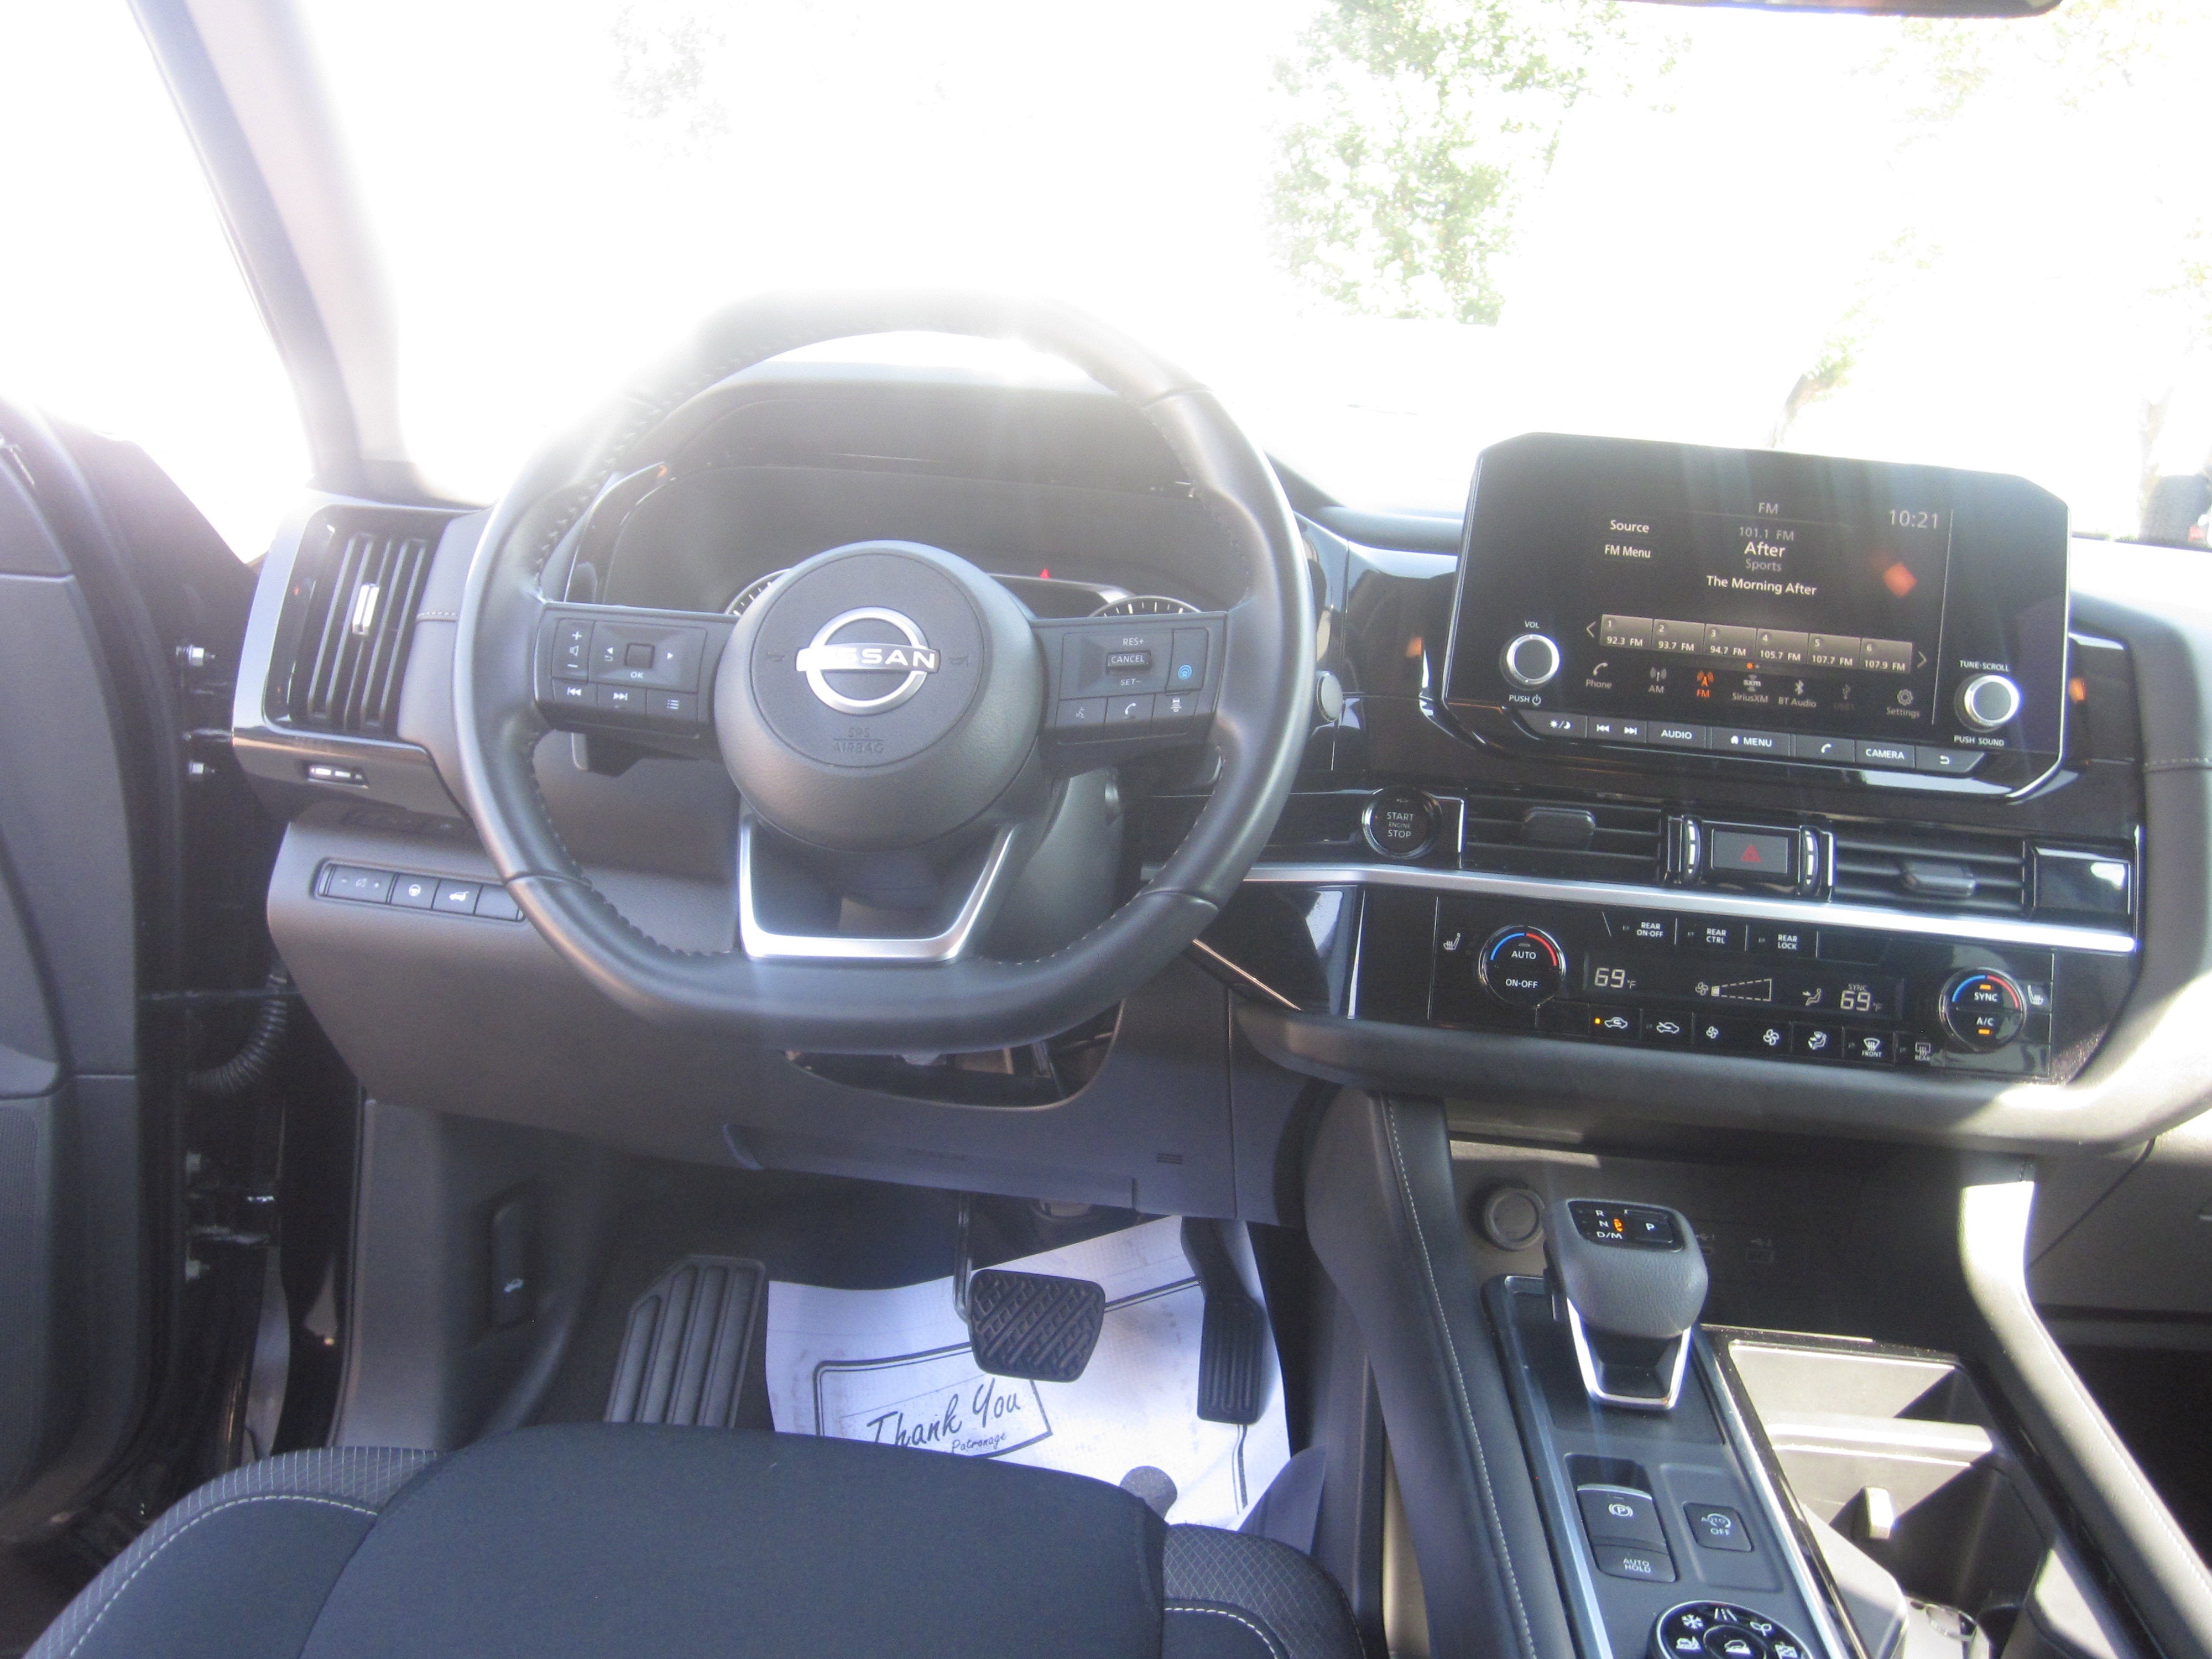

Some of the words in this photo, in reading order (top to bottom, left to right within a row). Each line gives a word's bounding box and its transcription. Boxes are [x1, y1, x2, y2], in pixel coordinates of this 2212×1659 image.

[1759, 502, 1779, 515] FM
[1890, 509, 1938, 529] 10:21
[1610, 519, 1650, 534] Source
[1739, 526, 1770, 540] 101.1
[1776, 529, 1795, 541] FM
[1604, 544, 1620, 556] FM
[1623, 546, 1651, 559] Menu
[1744, 541, 1786, 559] After
[1745, 559, 1782, 573] Sports
[1706, 575, 1728, 588] The
[1731, 577, 1782, 596] Morning
[1785, 582, 1818, 596] After
[1524, 620, 1540, 629] VOL
[1607, 620, 1612, 628] 1
[1658, 624, 1665, 633] 2
[1710, 629, 1717, 638] 3
[1762, 634, 1768, 643] 4
[1606, 636, 1626, 646] 92.3
[1629, 638, 1644, 647] FM
[1658, 640, 1677, 650] 93.7
[1681, 642, 1695, 652] FM
[1814, 639, 1820, 647] 5
[1710, 645, 1729, 655] 94.7
[1733, 647, 1746, 657] FM
[1866, 643, 1872, 652] 6
[1760, 650, 1783, 660] 105.7
[1787, 652, 1801, 662] FM
[1811, 655, 1836, 665] 107.7
[1839, 657, 1853, 667] FM
[1864, 659, 1888, 670] 107.9
[1892, 662, 1906, 672] FM
[1585, 679, 1612, 690] Phone
[1648, 685, 1664, 694] AM
[1509, 694, 1531, 704] PUSH
[1696, 689, 1711, 698] FM
[1731, 692, 1768, 704] SiriusXM
[1778, 696, 1791, 706] BT
[1792, 697, 1817, 708] Audio
[1886, 706, 1921, 719] Settings
[1661, 729, 1692, 740] AUDIO
[1743, 736, 1772, 748] MENU
[1953, 734, 1975, 745] PUSH
[1978, 737, 2005, 748] SOUND
[834, 742, 884, 753] AIRBAG
[1865, 748, 1905, 760] CAMERA
[1386, 812, 1415, 821] START
[1387, 830, 1412, 838] STOP
[1640, 921, 1661, 930] REAR
[1706, 928, 1727, 937] REAR
[1705, 936, 1726, 945] CTRL
[1777, 934, 1798, 943] REAR
[1777, 942, 1797, 951] LOCK
[1510, 950, 1537, 961] AUTO
[1974, 992, 1999, 1003] SYNC
[1976, 1016, 1994, 1027] A/C
[1861, 1050, 1882, 1058] FRONT
[1646, 1222, 1655, 1231] P
[1596, 1230, 1623, 1240] D/M
[867, 1393, 963, 1448] Thank
[972, 1377, 1022, 1428] You
[950, 1432, 1008, 1454] Patronage
[1710, 1527, 1730, 1536] OFF
[1623, 1558, 1650, 1567] AUTO
[1624, 1564, 1651, 1574] HOLD
